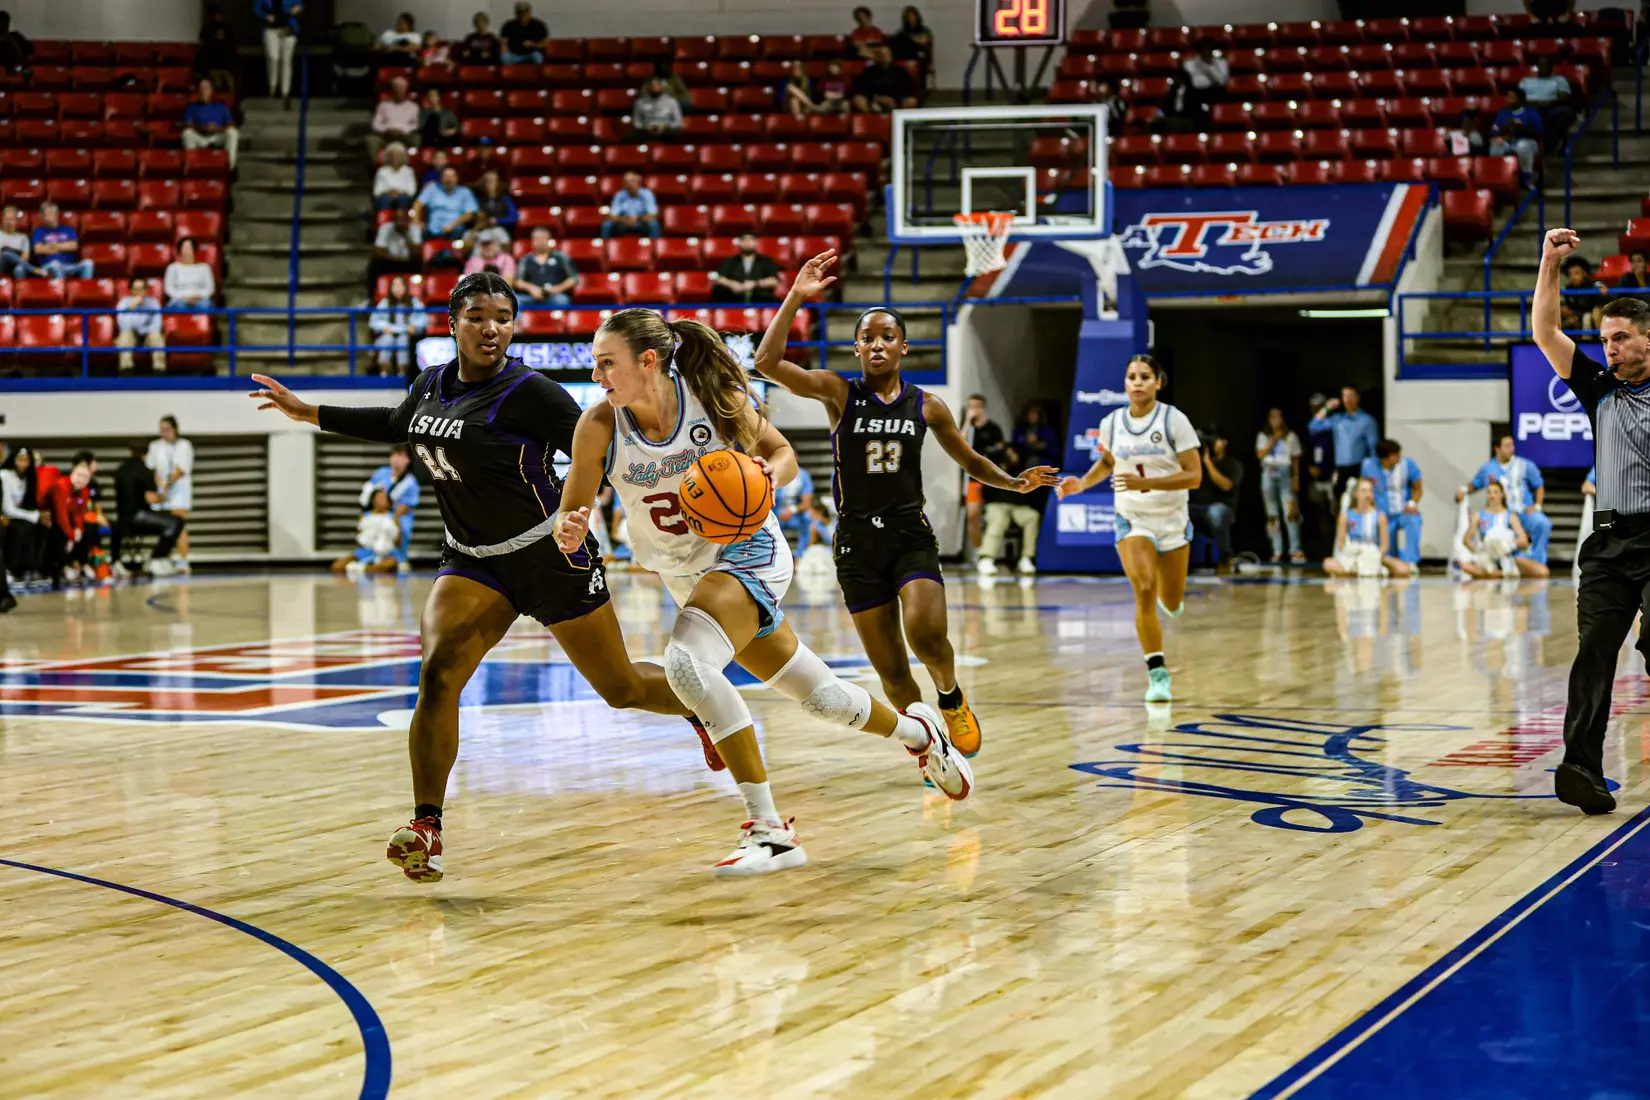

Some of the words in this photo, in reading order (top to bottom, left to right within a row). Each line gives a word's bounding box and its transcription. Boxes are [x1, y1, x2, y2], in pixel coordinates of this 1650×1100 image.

[993, 0, 1049, 37] 28
[407, 413, 465, 440] LSUA
[853, 417, 916, 436] LSUA
[414, 443, 463, 483] 24
[865, 439, 904, 474] 23
[622, 461, 661, 489] Lady
[641, 491, 690, 536] 2
